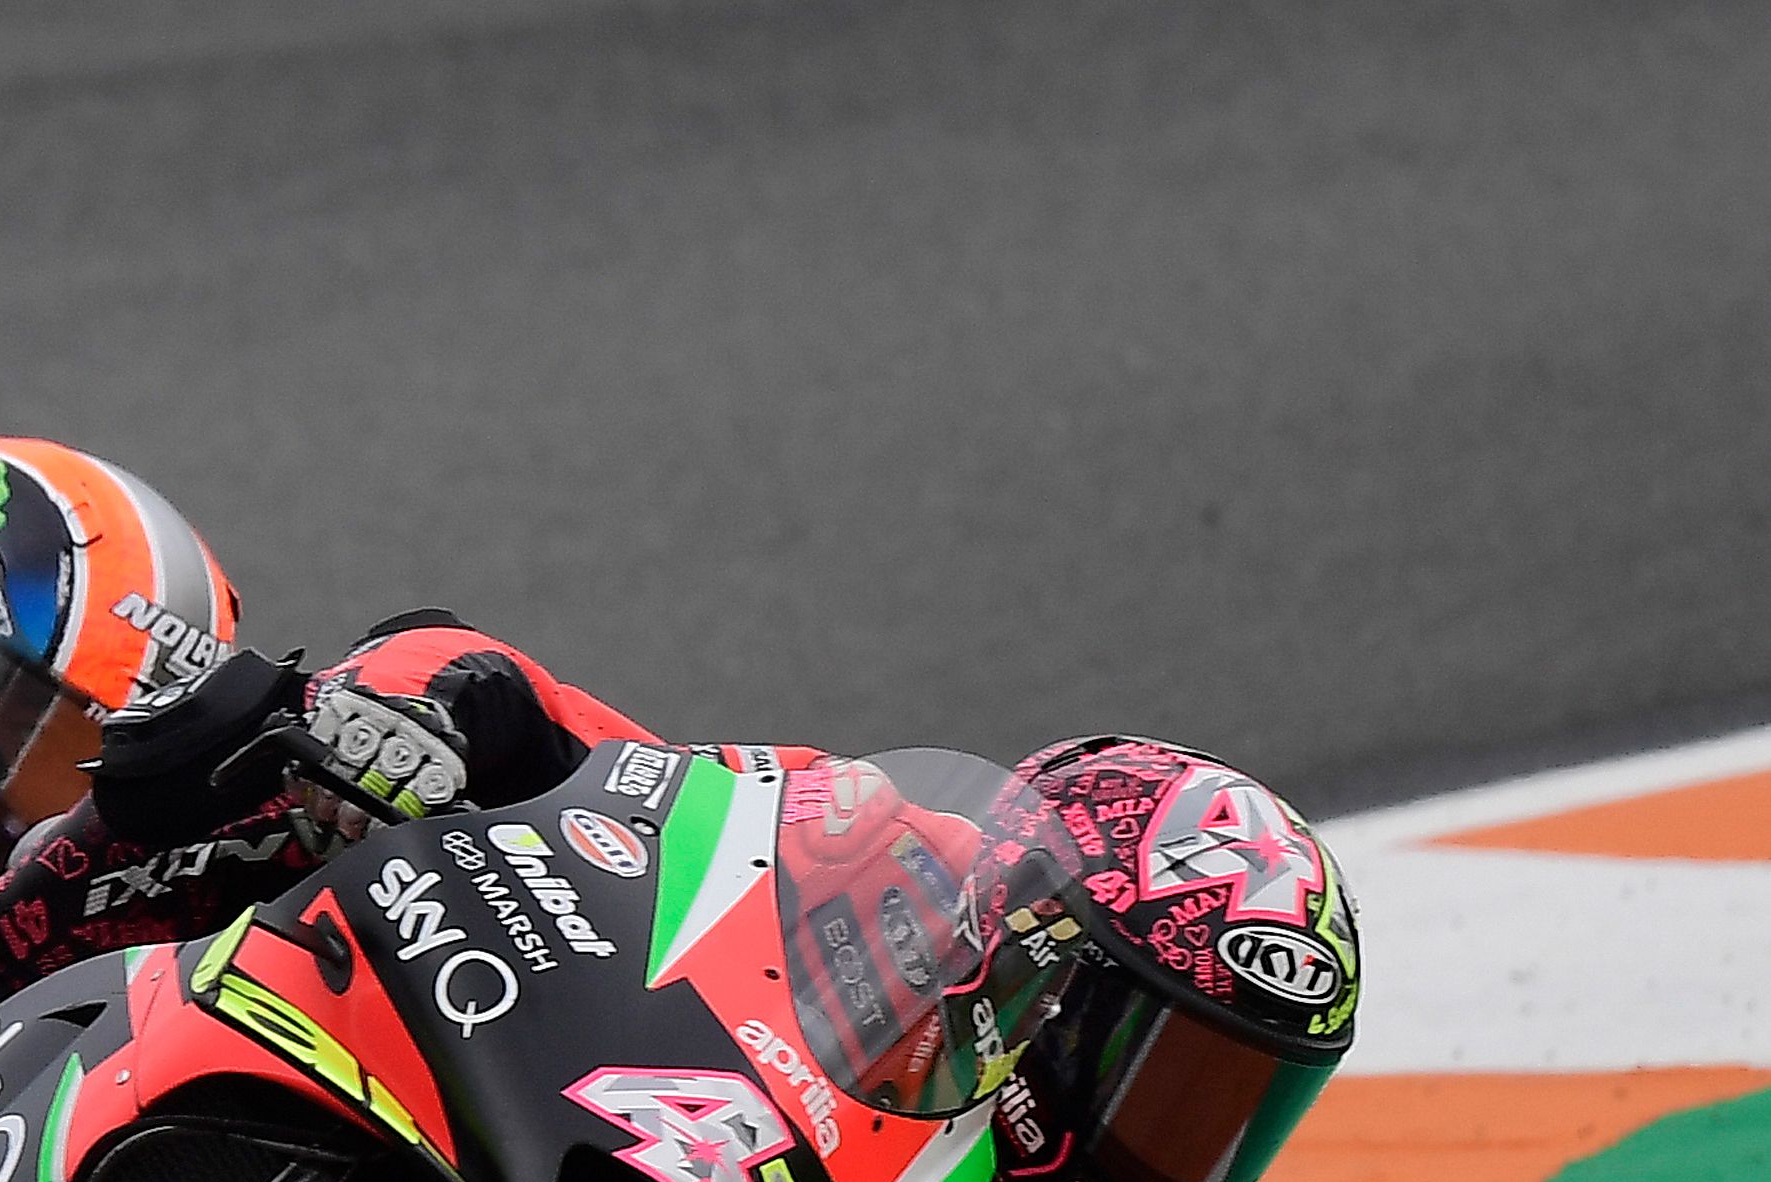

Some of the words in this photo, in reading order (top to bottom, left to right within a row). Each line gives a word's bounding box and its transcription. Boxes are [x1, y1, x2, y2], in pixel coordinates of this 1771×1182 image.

[472, 872, 559, 973] MARSH
[487, 824, 618, 958] Unibat
[434, 949, 520, 1039] Q
[1019, 930, 1062, 969] Air
[735, 1019, 841, 1157] aprilia
